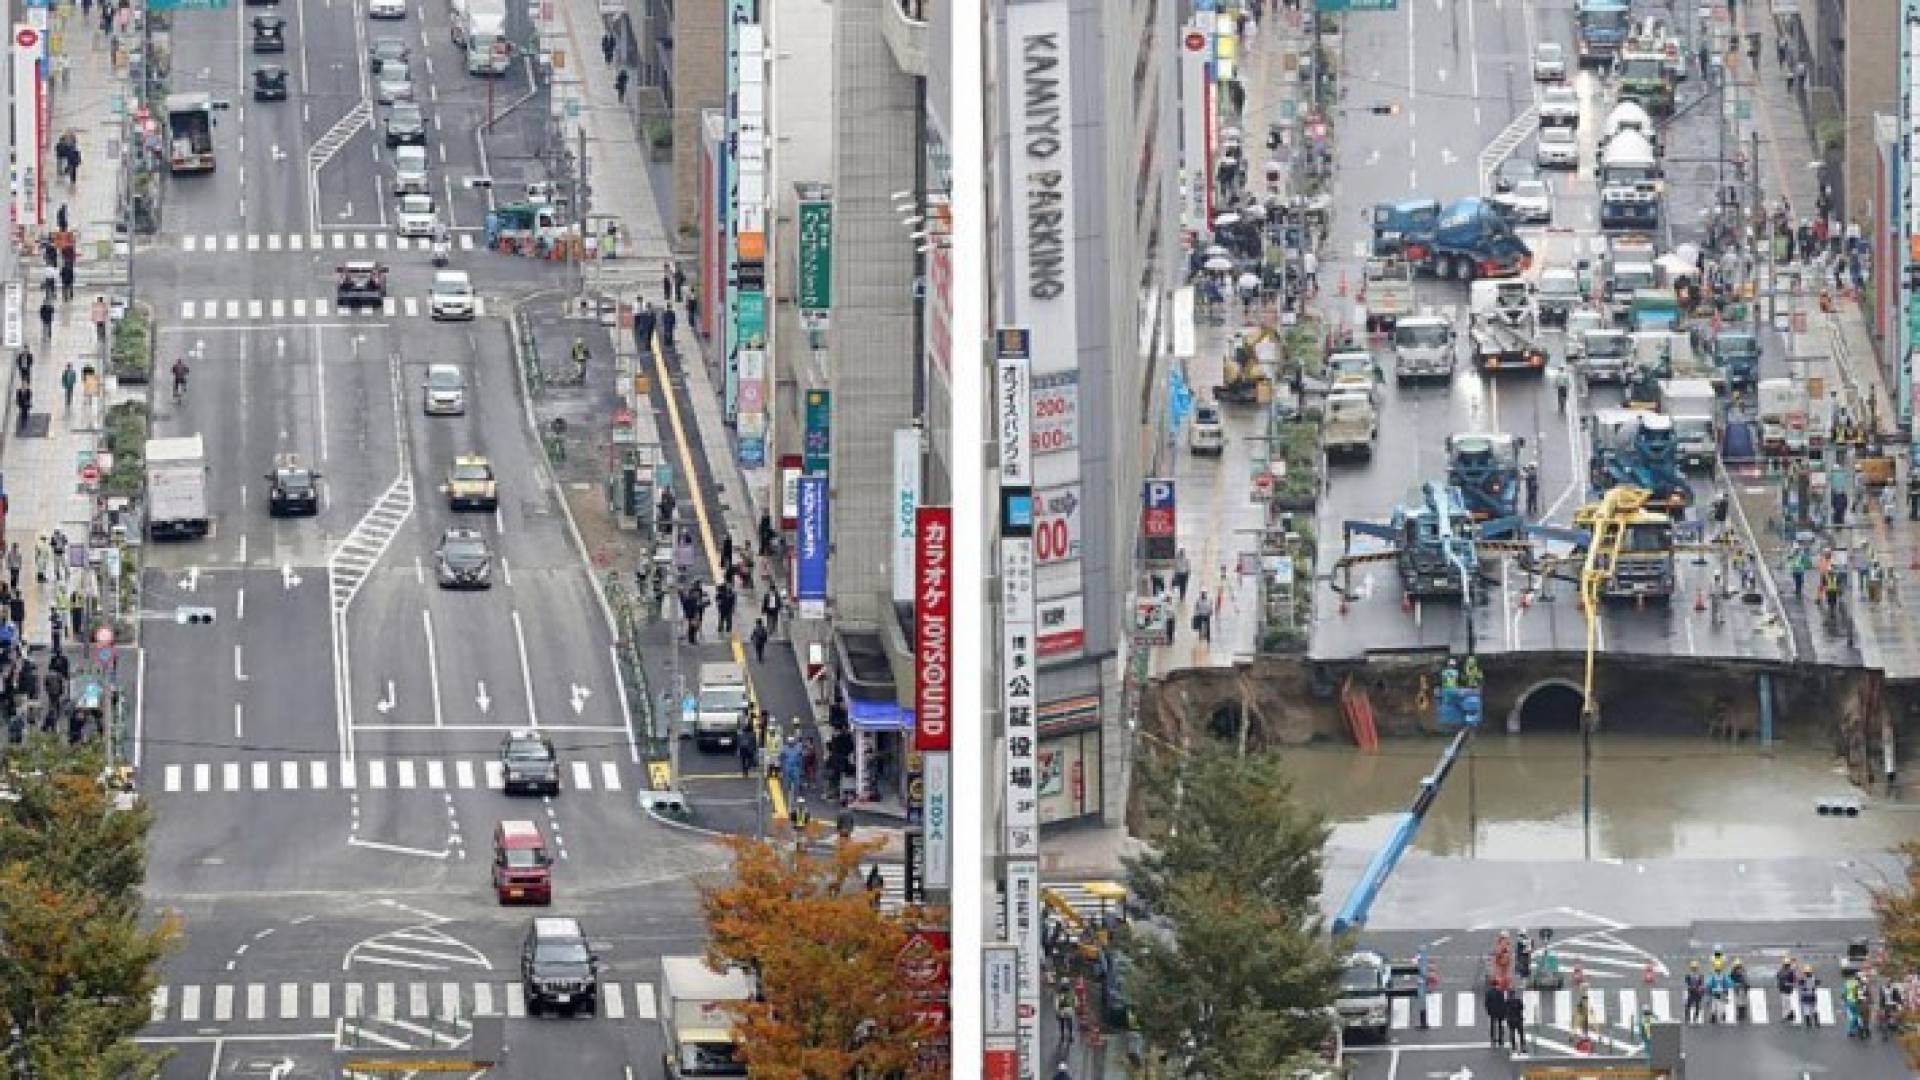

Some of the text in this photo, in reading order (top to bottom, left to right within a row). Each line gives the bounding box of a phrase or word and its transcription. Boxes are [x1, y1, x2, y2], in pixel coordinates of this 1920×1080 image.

[1023, 32, 1065, 301] KAMIYO PARKING
[1149, 484, 1170, 507] P
[923, 520, 946, 609] カラオケ
[923, 613, 946, 736] JOYSOUND
